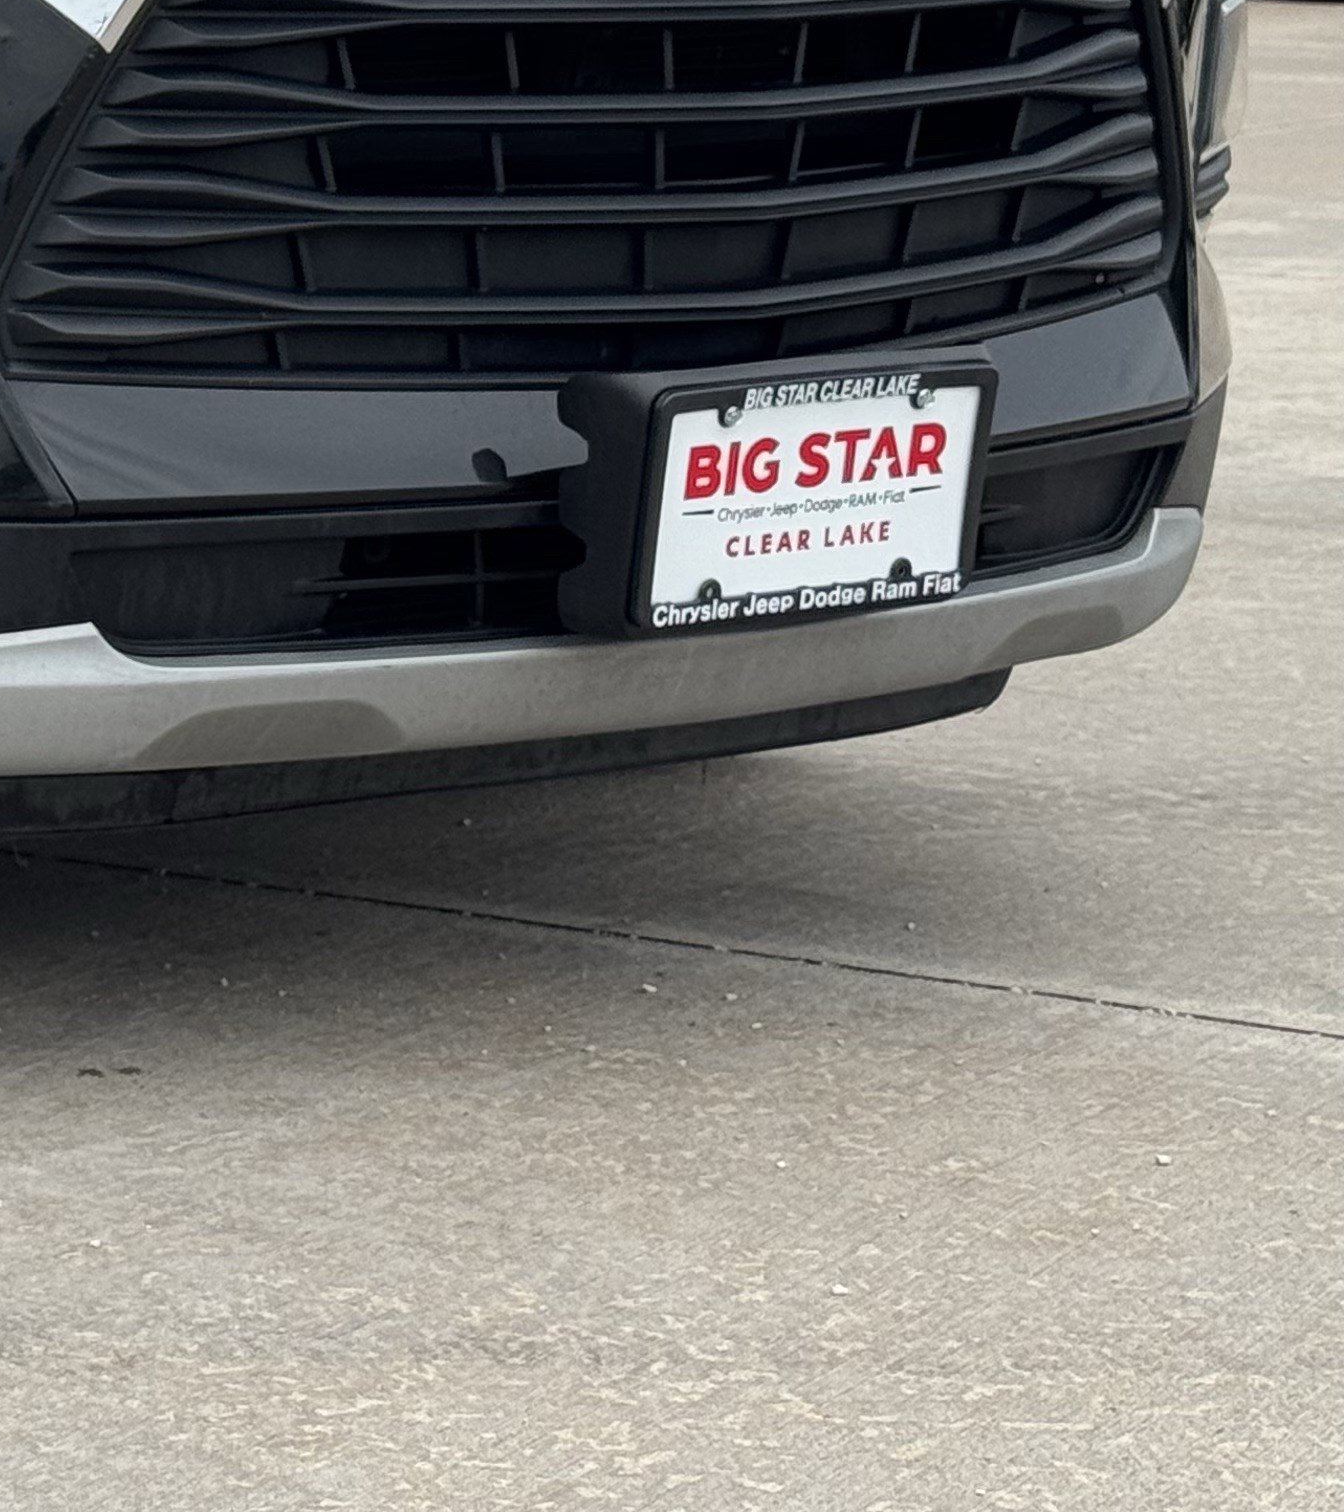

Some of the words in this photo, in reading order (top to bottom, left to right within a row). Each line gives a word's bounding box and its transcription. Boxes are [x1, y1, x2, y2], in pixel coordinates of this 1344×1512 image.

[744, 387, 773, 410] BIG
[775, 381, 817, 407] STAR
[820, 377, 874, 403] CLEAR
[875, 373, 921, 397] LAKE
[683, 435, 781, 501] BIG
[794, 422, 948, 488] STAR
[726, 528, 810, 558] CLEAR
[824, 520, 891, 548] LAKE
[652, 597, 739, 629] Chrysler
[743, 593, 794, 621] Jeep
[799, 584, 866, 612] Dodge
[872, 578, 917, 602] Ram
[923, 571, 963, 596] Fiat
